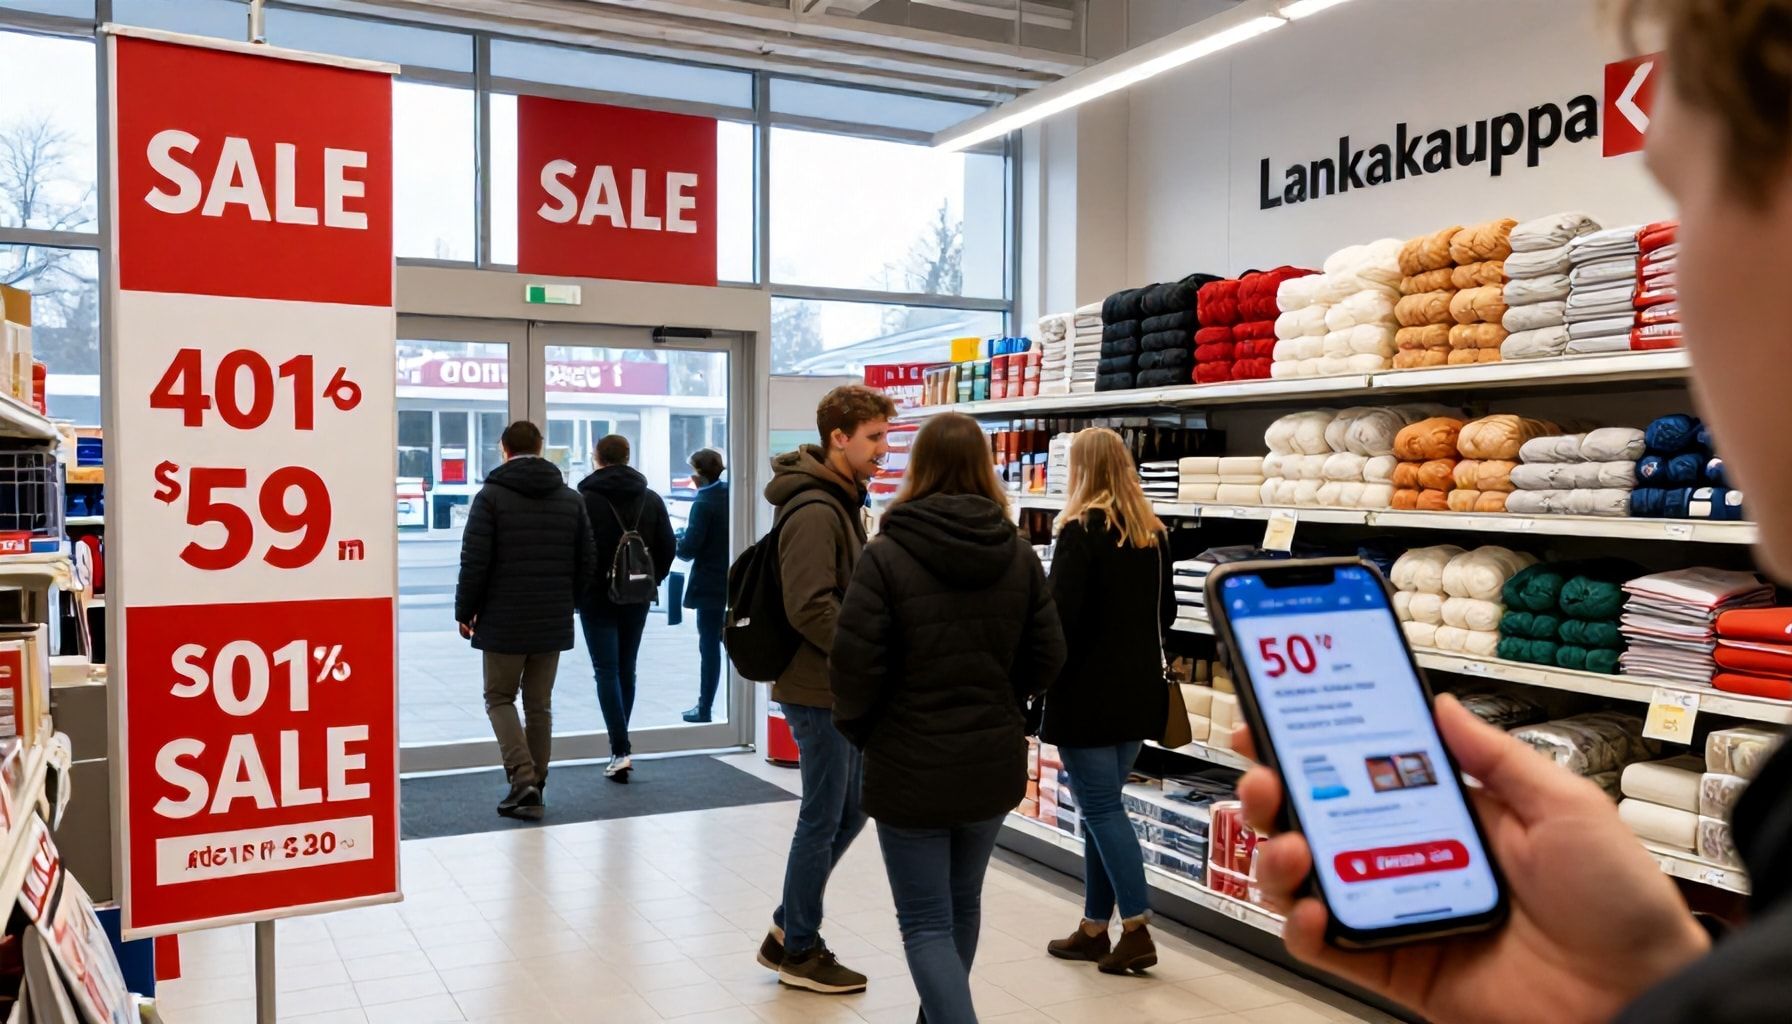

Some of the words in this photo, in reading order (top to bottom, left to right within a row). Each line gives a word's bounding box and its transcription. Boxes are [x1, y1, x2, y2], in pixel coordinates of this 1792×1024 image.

[144, 129, 368, 230] SALE
[537, 159, 698, 234] SALE
[1260, 94, 1599, 210] Lankakauppa
[152, 725, 371, 819] SALE
